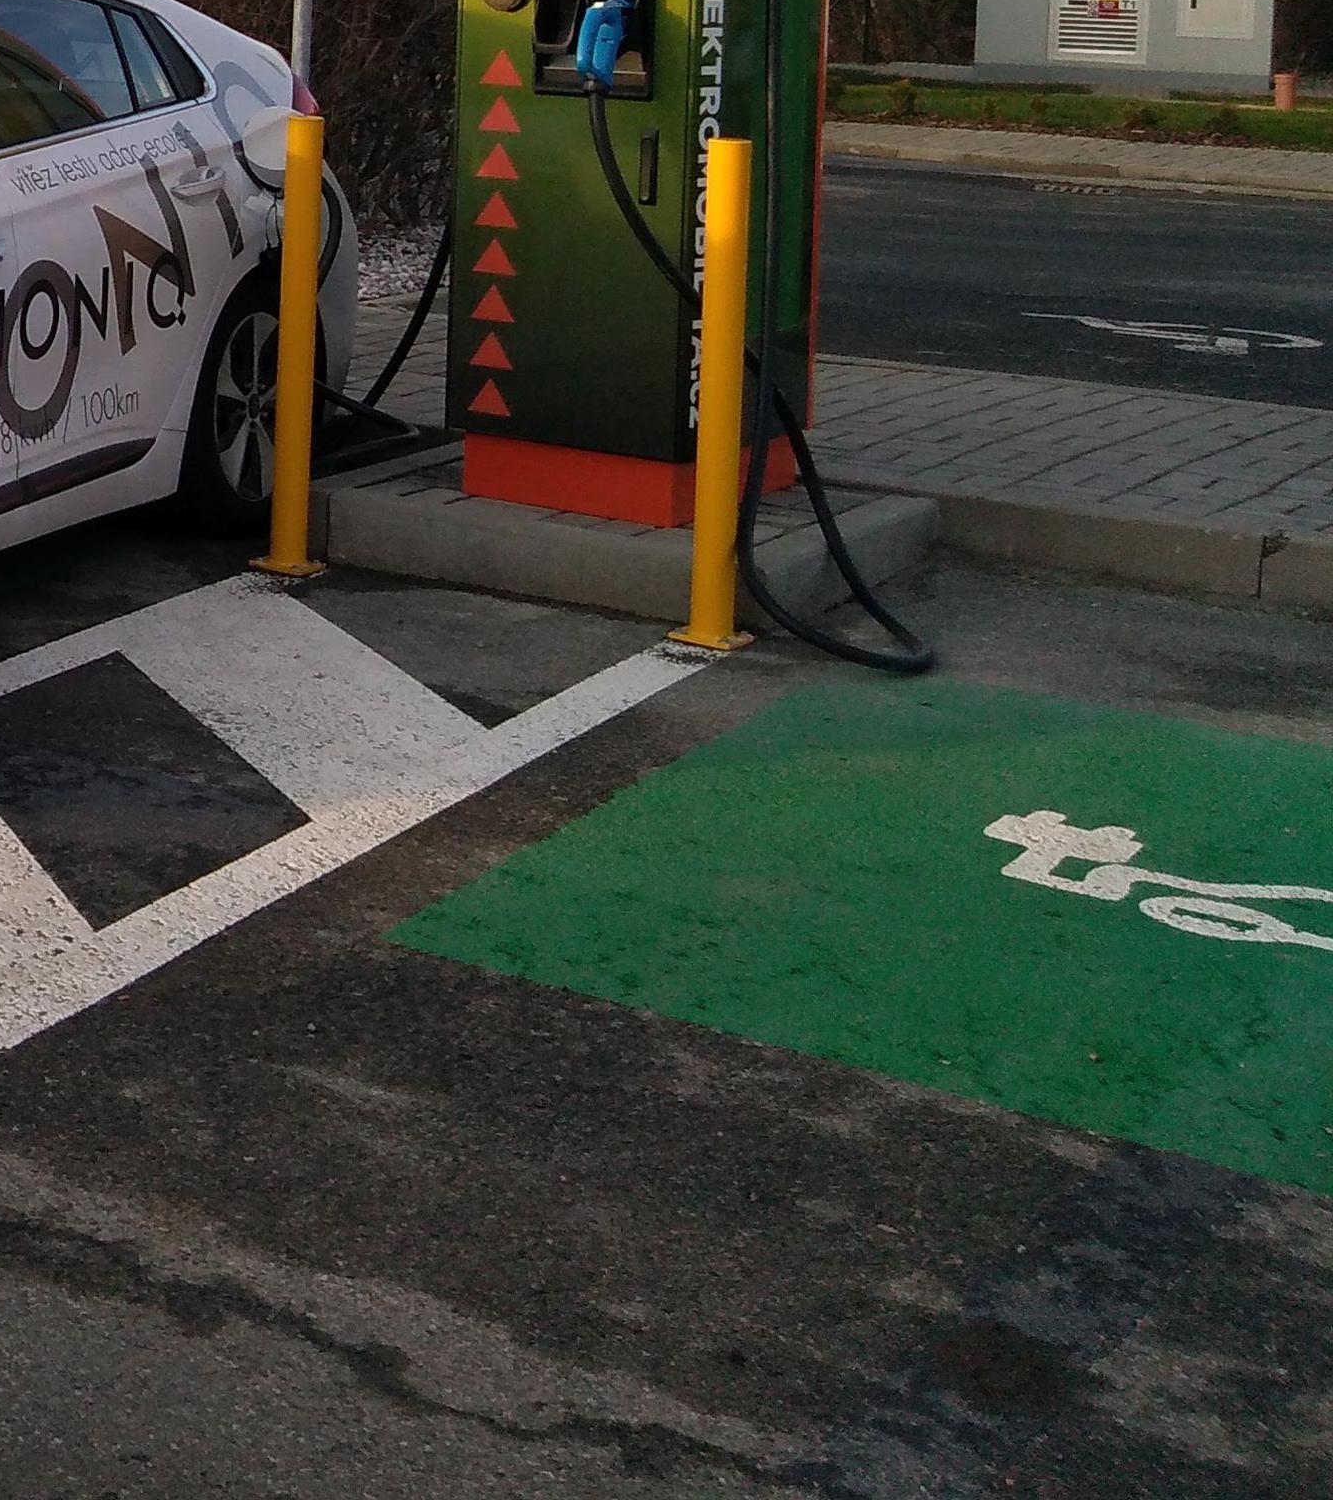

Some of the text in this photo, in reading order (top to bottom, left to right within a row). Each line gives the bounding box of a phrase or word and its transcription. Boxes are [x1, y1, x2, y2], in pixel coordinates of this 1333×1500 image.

[1121, 0, 1136, 10] T1
[9, 165, 60, 196] vítěz
[53, 157, 99, 184] testu
[99, 138, 146, 172] adac
[81, 383, 141, 428] 100km
